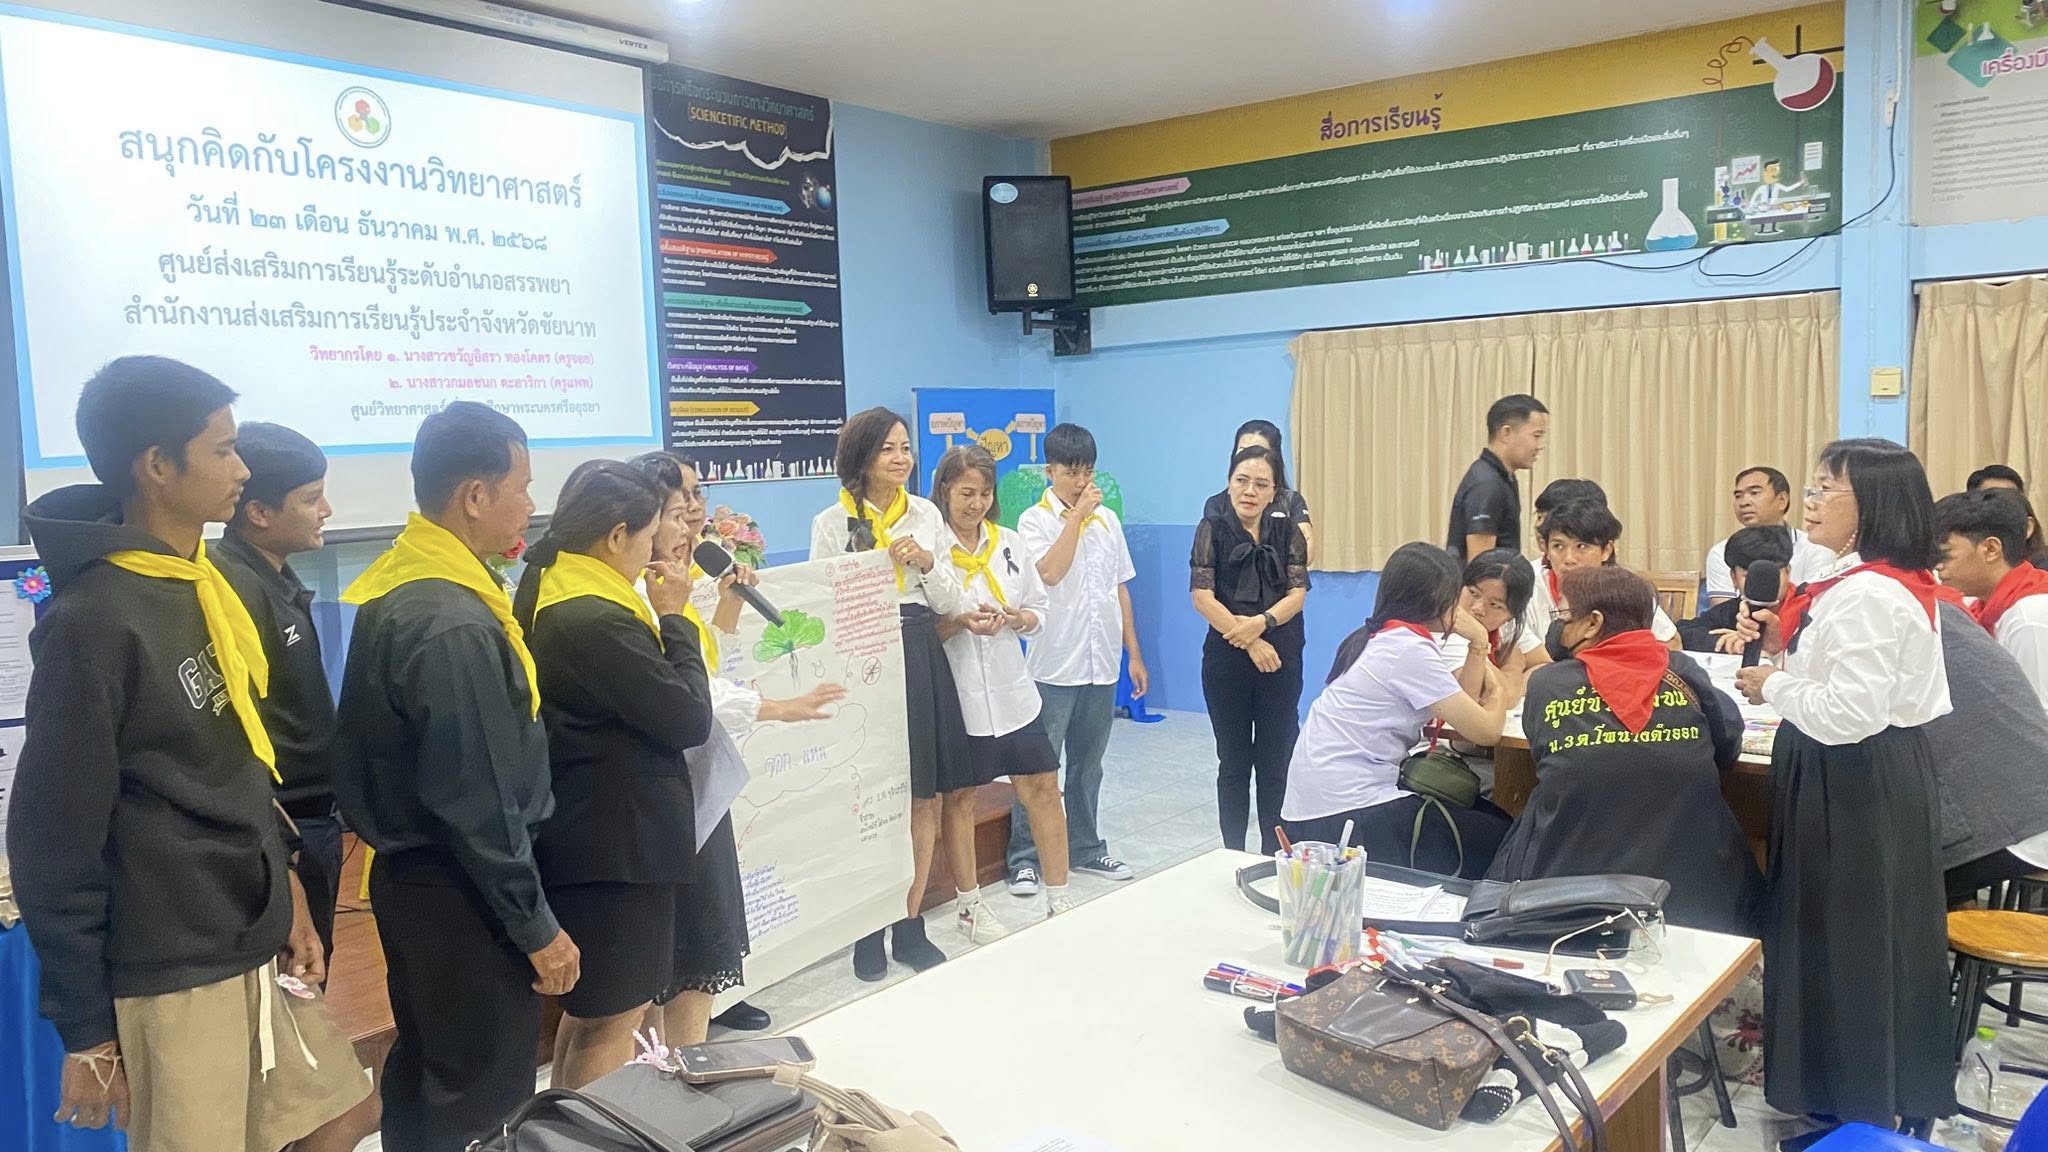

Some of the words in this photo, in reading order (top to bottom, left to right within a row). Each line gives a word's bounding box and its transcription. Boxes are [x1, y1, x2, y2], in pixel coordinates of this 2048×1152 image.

[619, 38, 648, 50] VERTEX
[1319, 93, 1443, 142] สื่อการเรียนรู้
[119, 125, 583, 209] สนุกคิดกับโครงงานวิทยาศาสตร์
[187, 192, 240, 228] วันที่
[250, 208, 286, 230] ๒๓
[296, 204, 349, 235] เดือน
[358, 208, 438, 242] ธันวาคม
[445, 222, 486, 247] พ.ศ.
[491, 227, 548, 252] ๒๕๖๘
[158, 245, 570, 296] ศูนย์ส่งเสริมการเรียนรู้ระดับอำเภอสรรพยา
[123, 296, 597, 340] สำนักงานส่งเสริมการเรียนรู้ประจำจังหวัดชัยนาท
